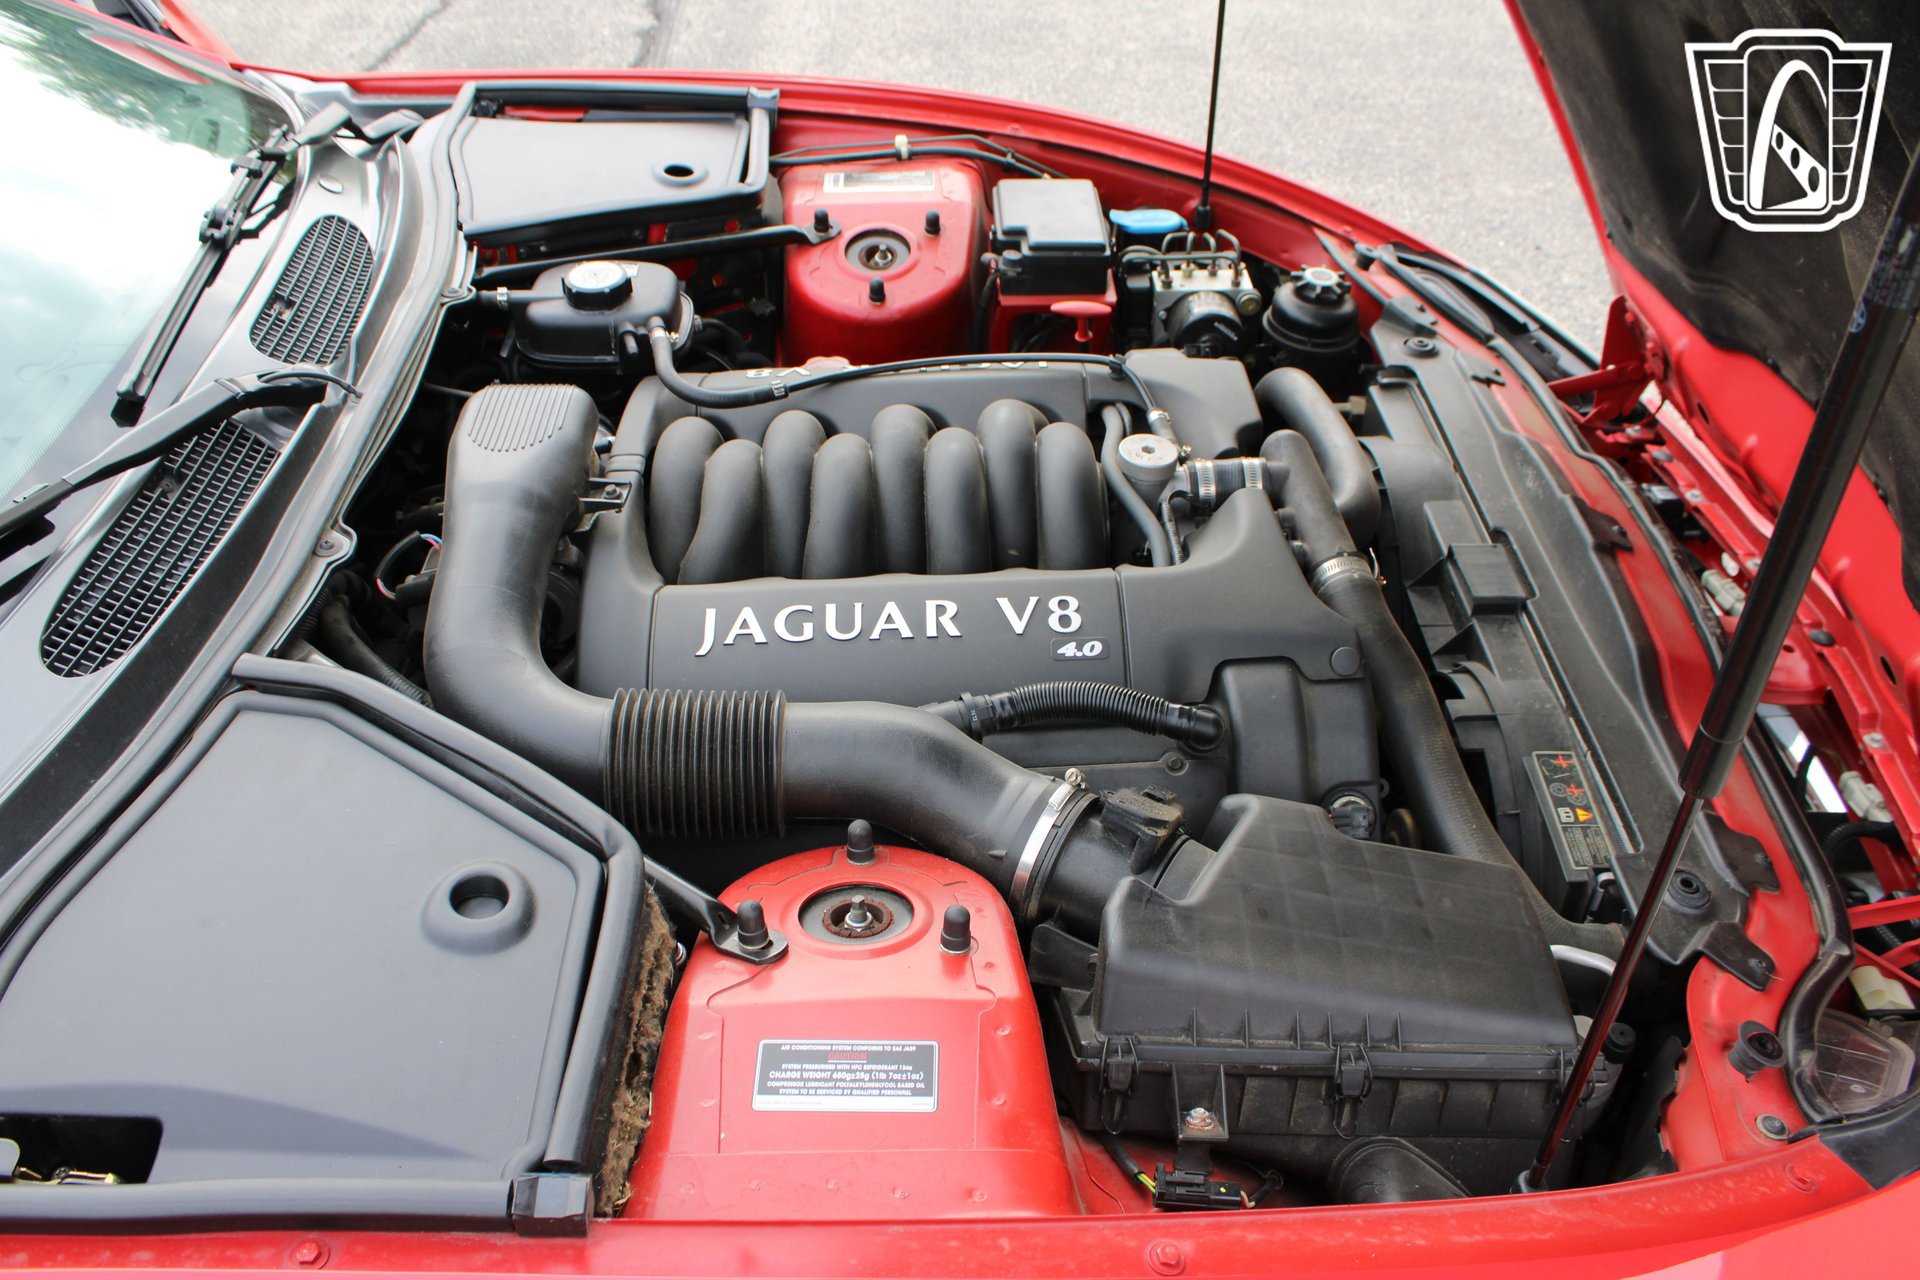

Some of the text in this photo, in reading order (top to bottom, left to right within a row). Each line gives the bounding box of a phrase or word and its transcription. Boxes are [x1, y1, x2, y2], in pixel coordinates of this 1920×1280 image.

[695, 595, 1083, 657] JAGUAR V8
[1057, 641, 1103, 657] 4.0
[827, 1052, 868, 1060] CAUTION
[769, 1071, 801, 1079] CHARGE
[802, 1071, 831, 1079] WEIGHT
[871, 1071, 887, 1080] (1lb
